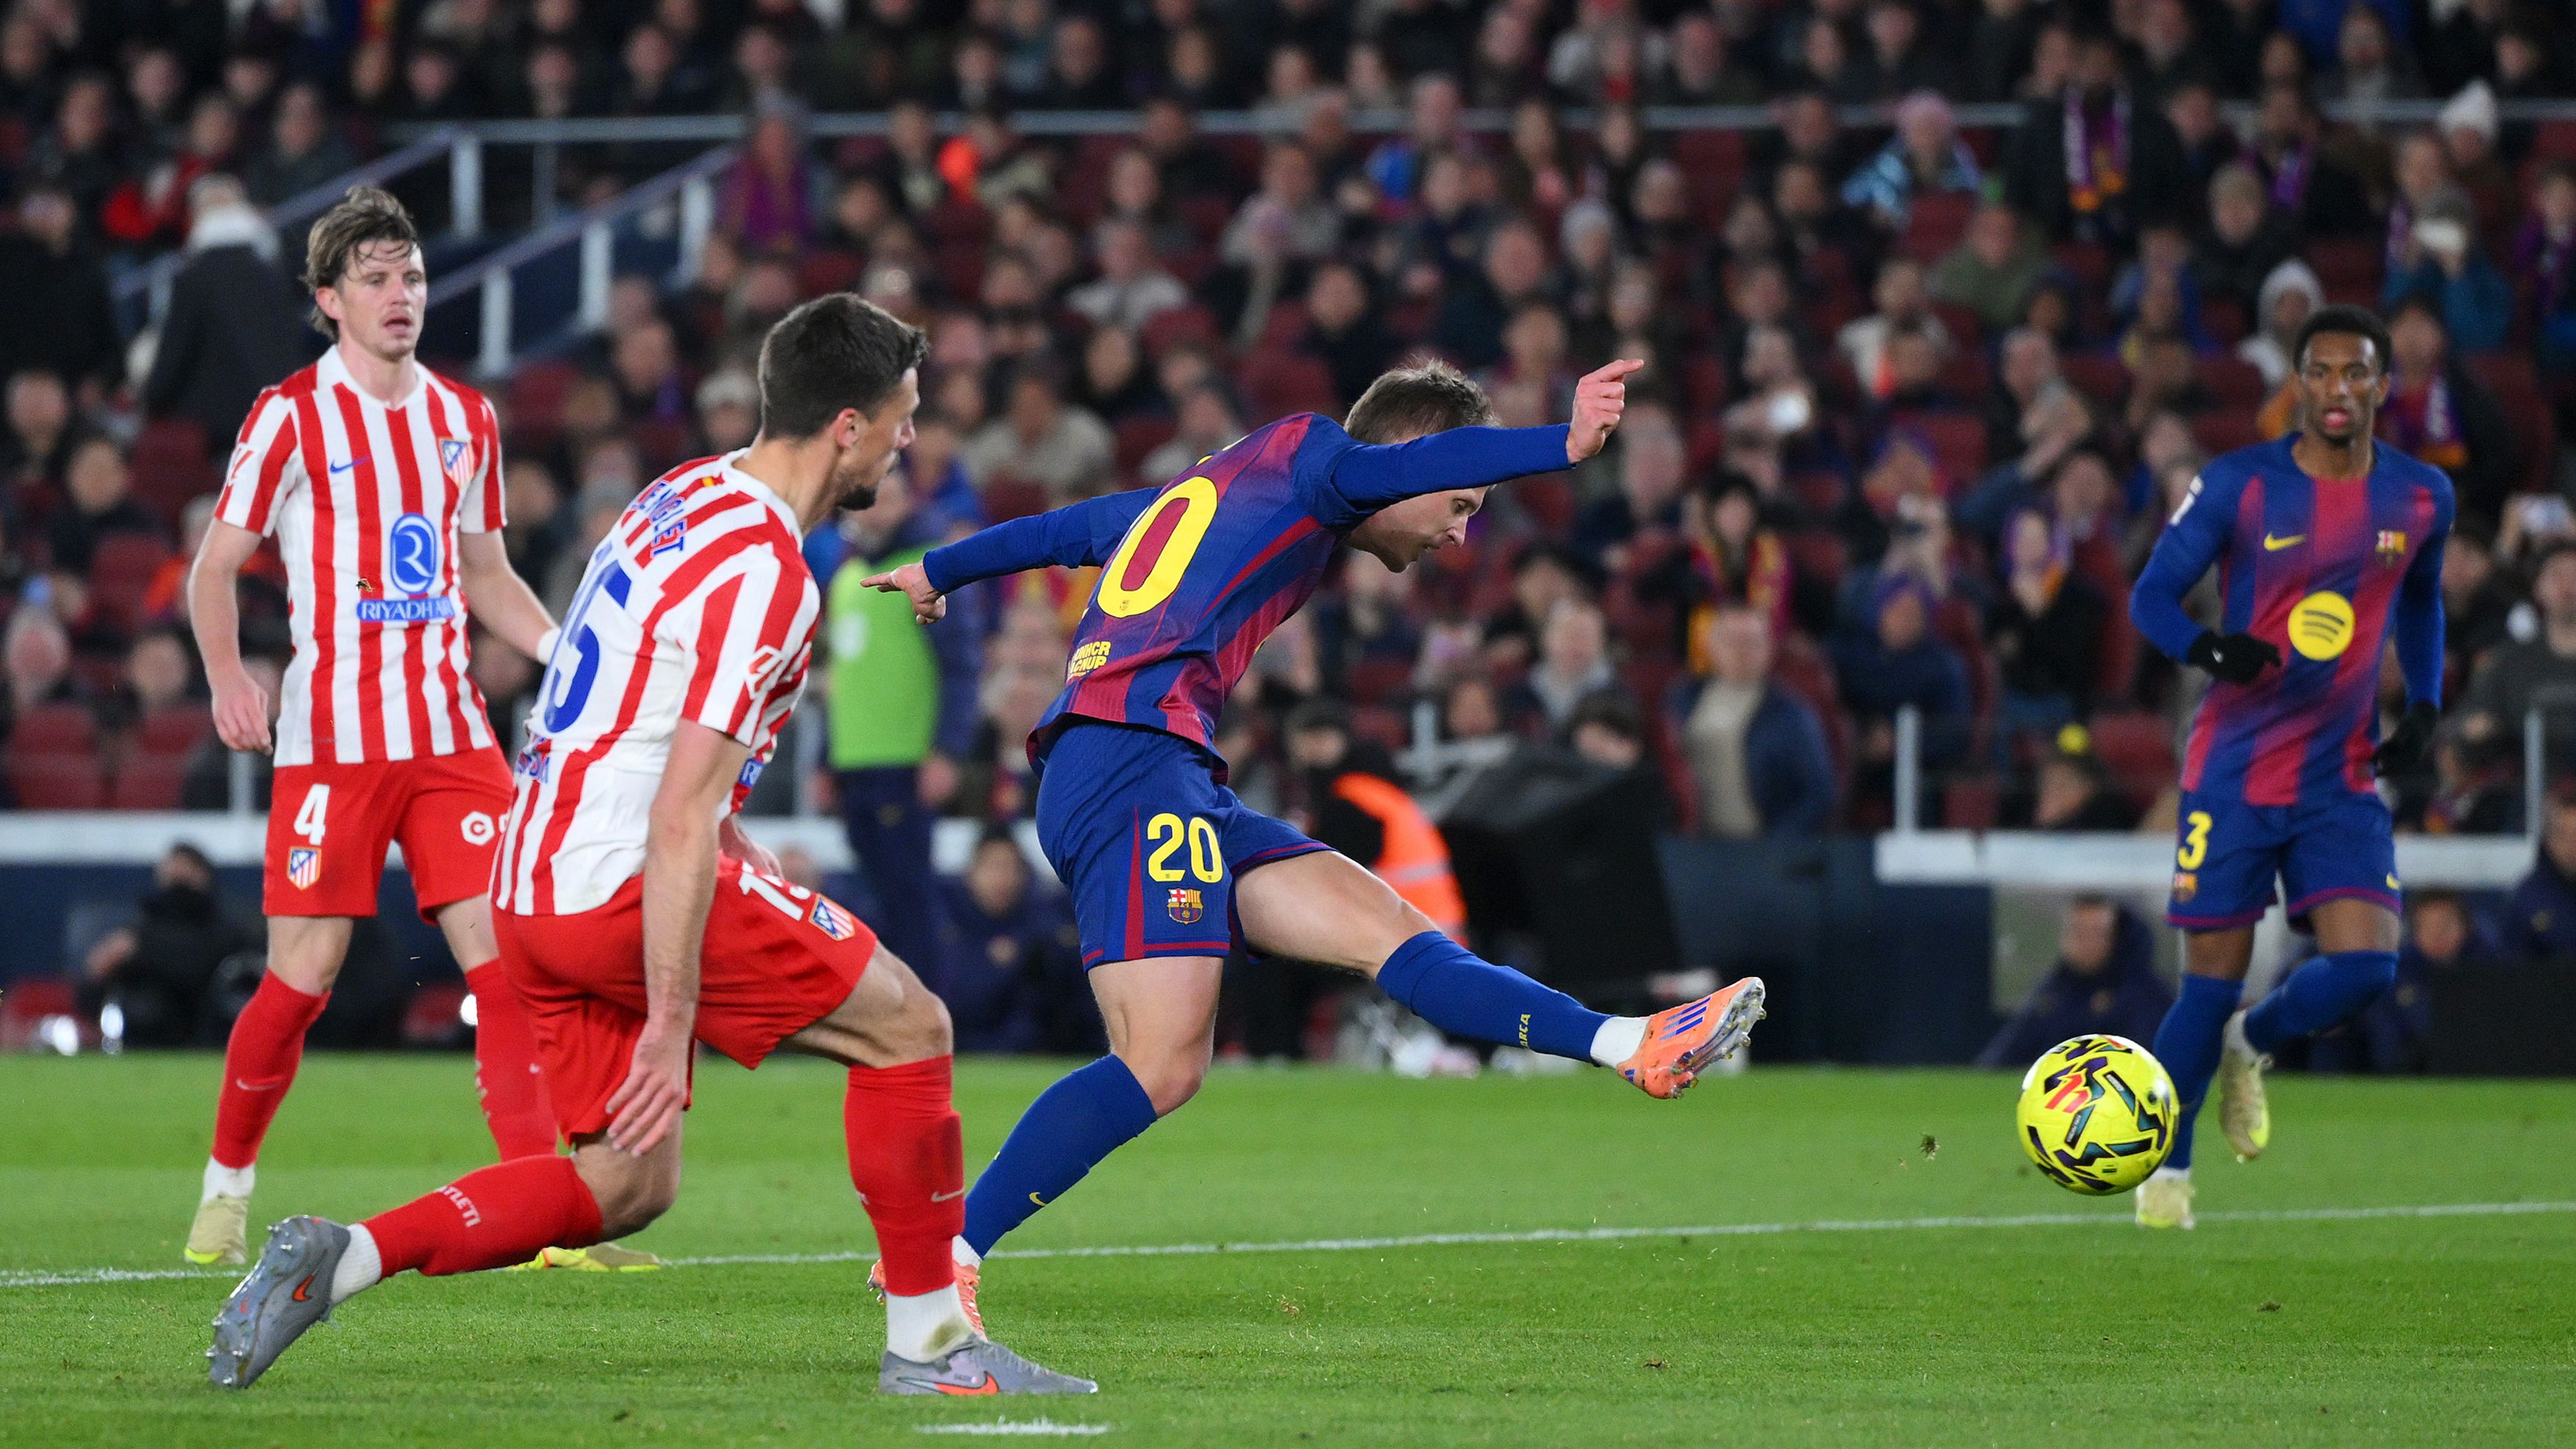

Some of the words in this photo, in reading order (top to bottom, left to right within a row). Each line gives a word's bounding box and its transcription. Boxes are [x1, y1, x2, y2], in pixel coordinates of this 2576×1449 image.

[631, 480, 684, 555] ENGLET
[1079, 476, 1218, 618] 0
[361, 601, 433, 619] RIYADH
[294, 783, 331, 845] 4
[2178, 811, 2213, 870] 3
[1147, 812, 1224, 884] 20
